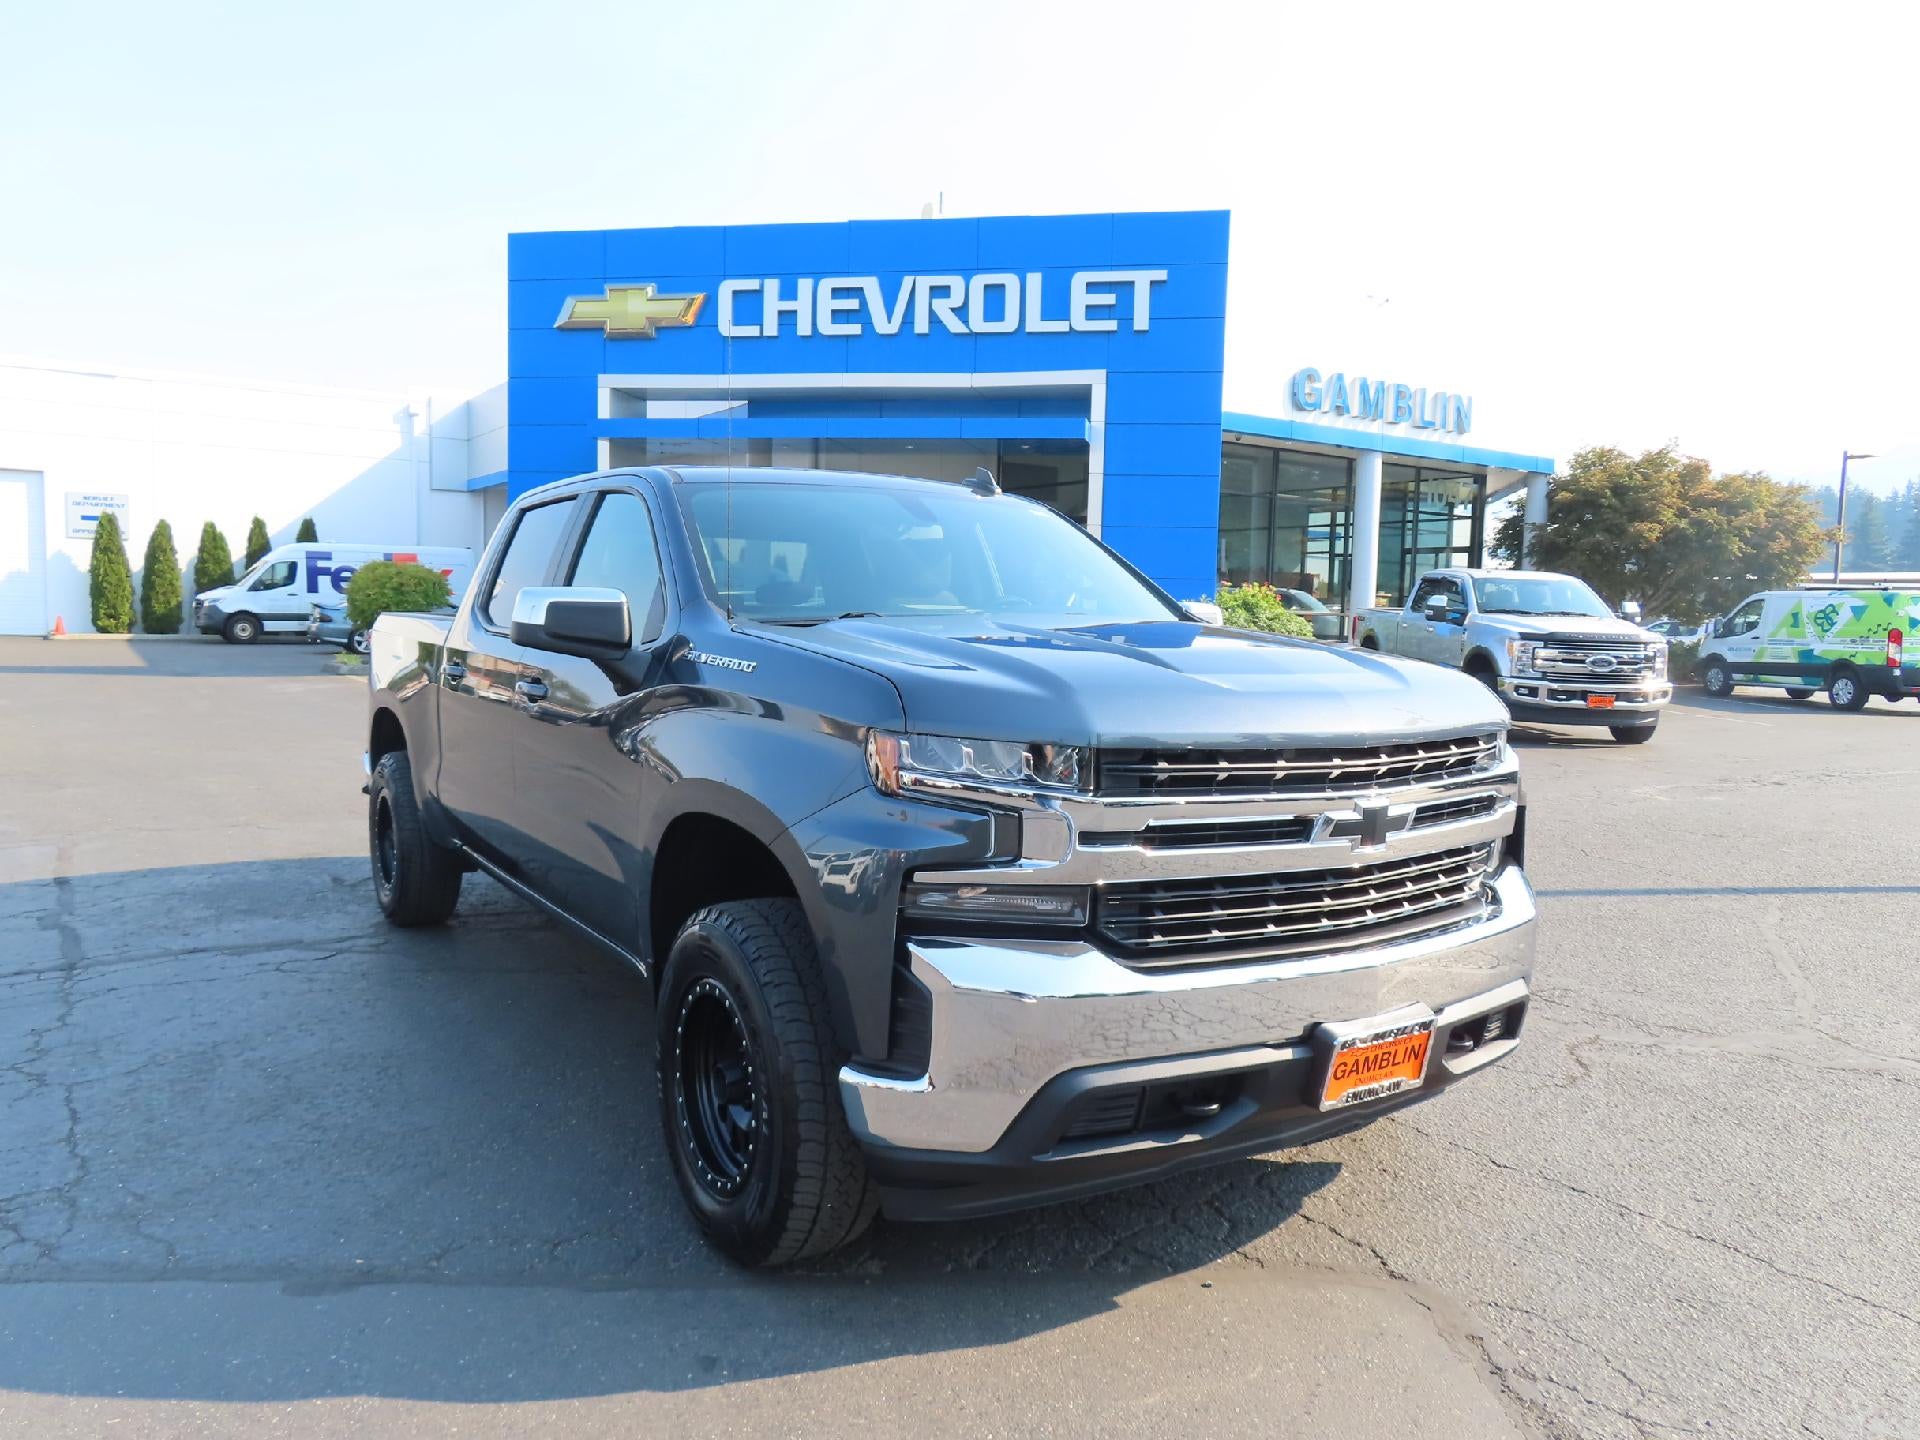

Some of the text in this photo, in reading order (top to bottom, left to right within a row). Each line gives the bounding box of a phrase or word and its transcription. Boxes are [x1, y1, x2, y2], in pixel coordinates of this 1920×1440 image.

[717, 269, 1168, 337] CHEVROLET
[1293, 366, 1473, 435] GAMBLIN
[1332, 1043, 1423, 1081] GAMBLIN
